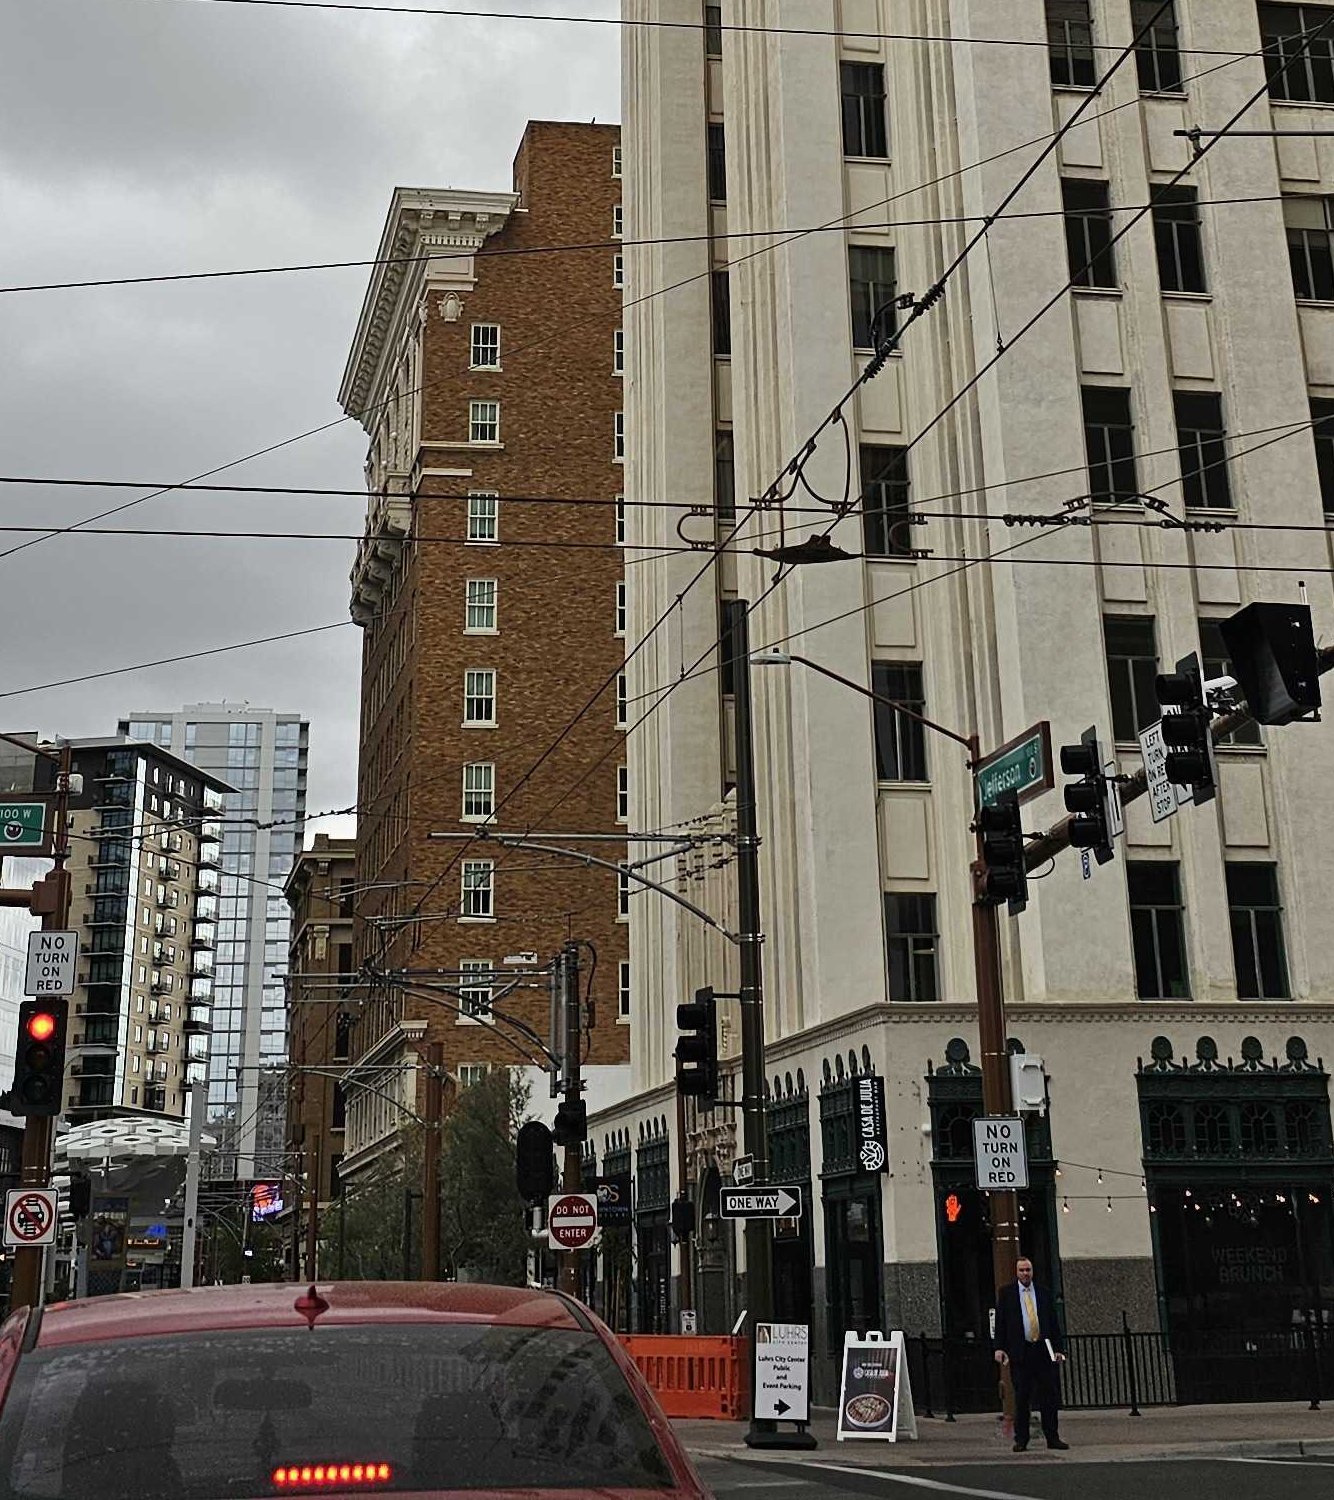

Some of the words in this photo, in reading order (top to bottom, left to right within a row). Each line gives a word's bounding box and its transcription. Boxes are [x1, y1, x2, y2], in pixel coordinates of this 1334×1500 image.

[1145, 731, 1161, 749] LEFT
[1147, 749, 1166, 765] TURN
[983, 763, 1021, 800] Jefferson
[1148, 769, 1157, 783] ON
[1152, 781, 1172, 797] AFTER
[1156, 796, 1171, 814] STOP
[0, 809, 19, 819] 100
[23, 809, 32, 819] W
[41, 936, 65, 950] NO
[35, 952, 69, 964] TURN
[42, 966, 60, 977] ON
[37, 980, 63, 991] RED
[859, 1078, 874, 1102] JULIA
[860, 1103, 874, 1115] DE
[861, 1115, 875, 1138] CASA
[986, 1124, 1011, 1139] NO
[982, 1142, 1018, 1154] TURN
[992, 1157, 1010, 1168] ON
[989, 1172, 1015, 1183] RED
[729, 1197, 752, 1209] ONE
[755, 1196, 779, 1208] WAY
[556, 1206, 568, 1215] DO
[573, 1205, 590, 1214] NOT
[559, 1228, 587, 1239] ENTER
[1211, 1244, 1288, 1264] WEEKEND
[772, 1326, 808, 1340] LUHRS
[775, 1355, 787, 1363] City
[776, 1373, 788, 1381] and
[779, 1382, 802, 1391] Parking
